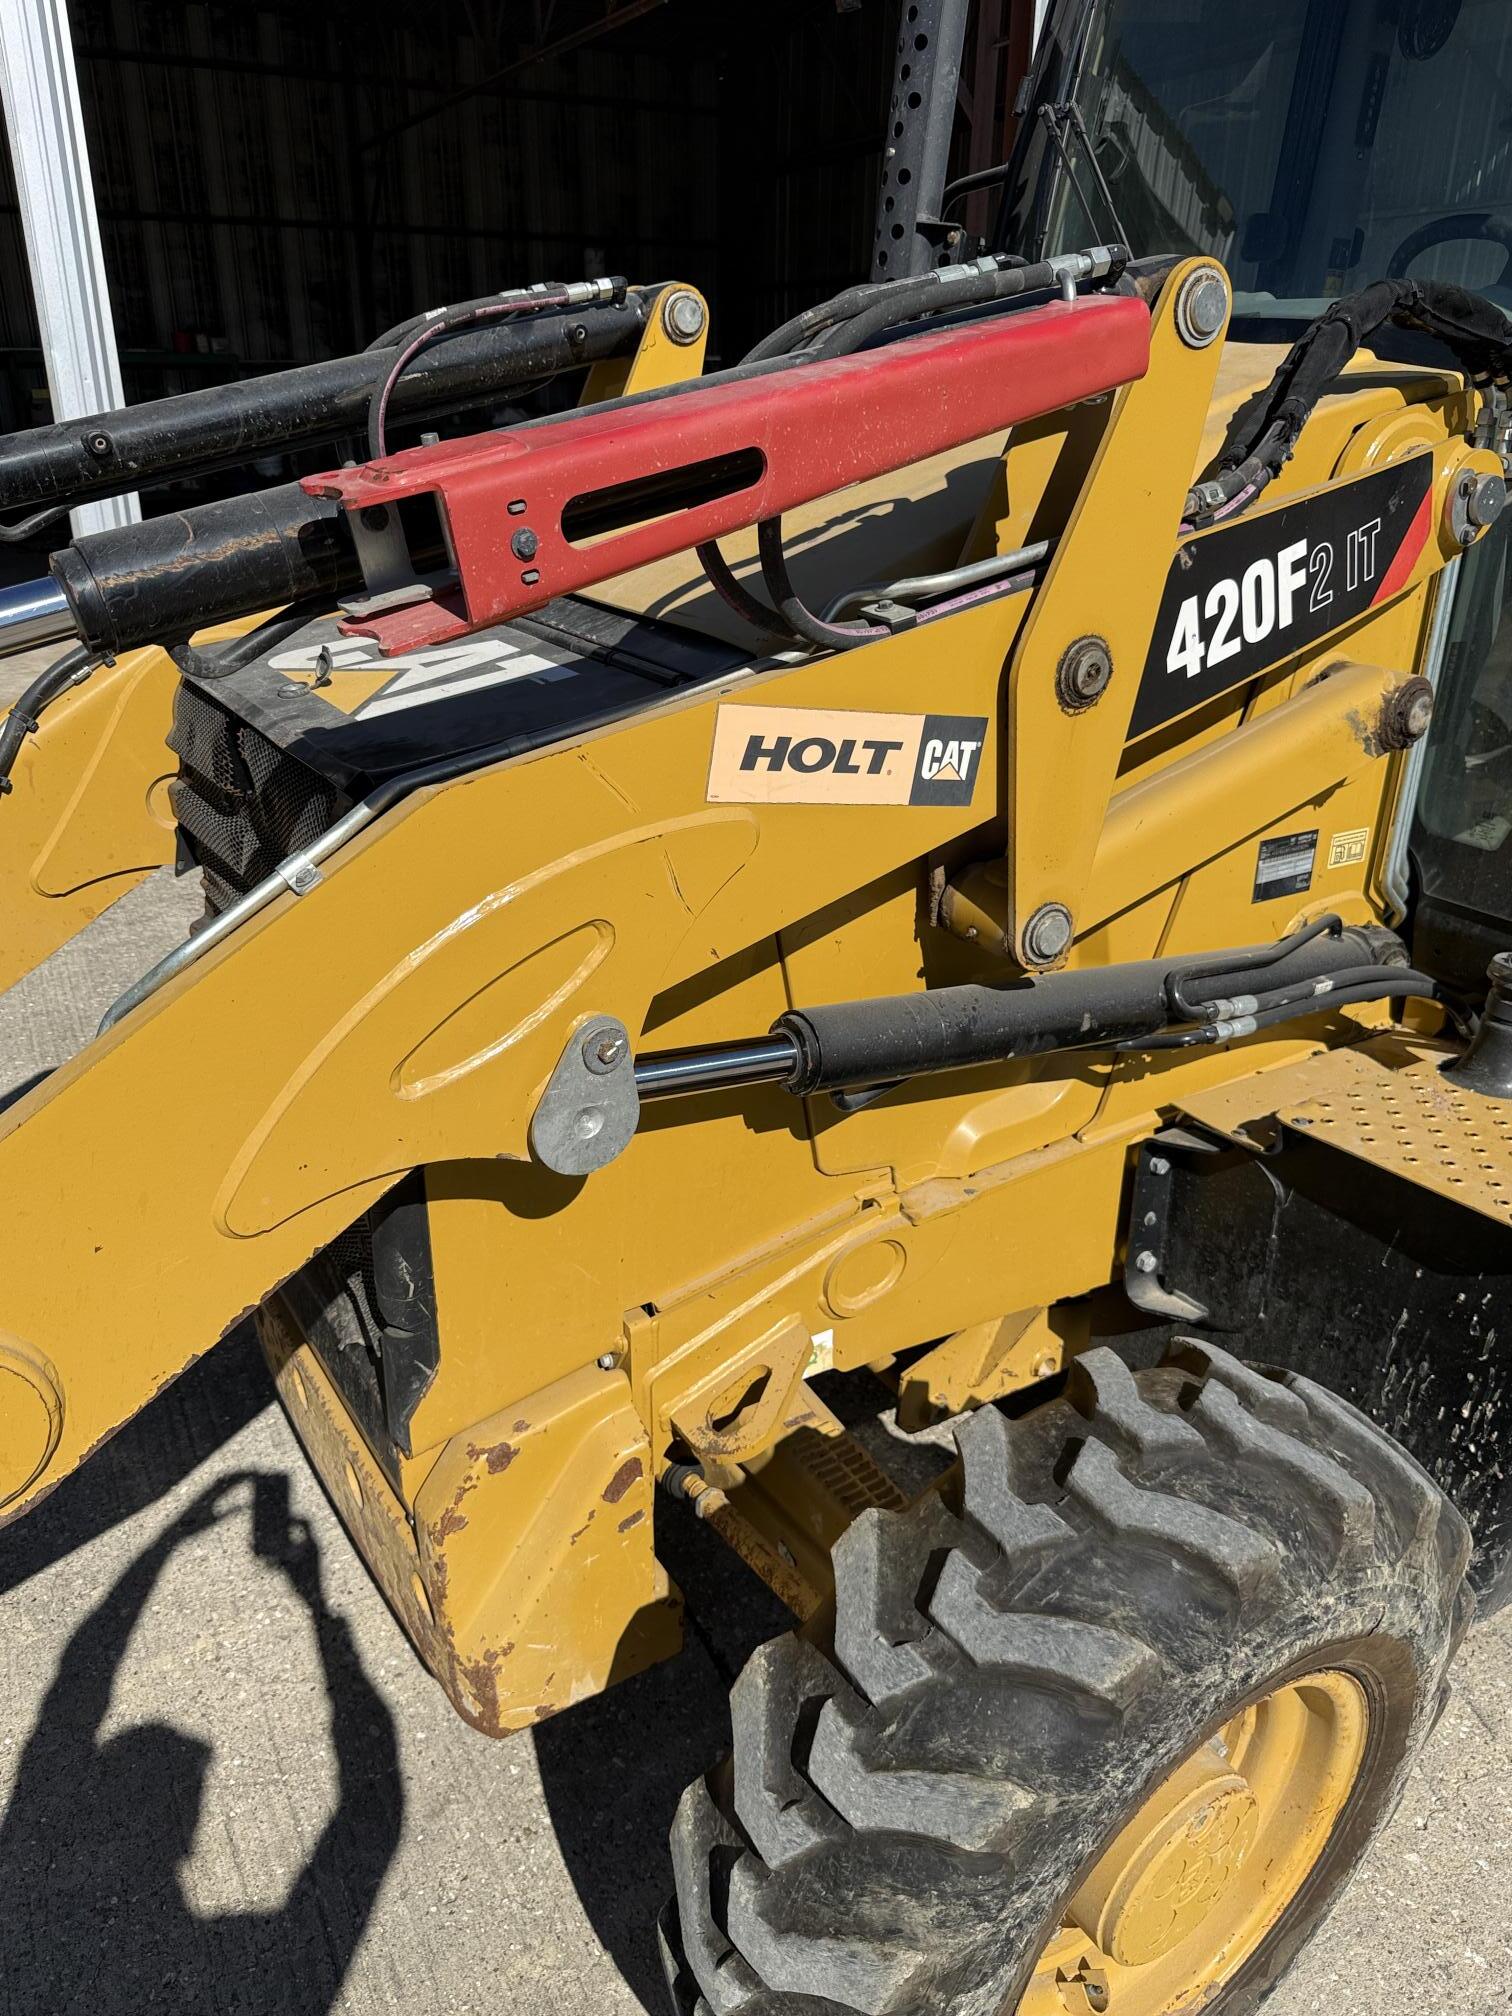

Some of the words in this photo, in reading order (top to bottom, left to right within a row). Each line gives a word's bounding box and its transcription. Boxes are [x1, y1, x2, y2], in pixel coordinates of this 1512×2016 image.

[1346, 517, 1381, 592] IT
[267, 636, 581, 721] CAT
[739, 735, 904, 776] HOLT
[921, 738, 978, 781] CAT
